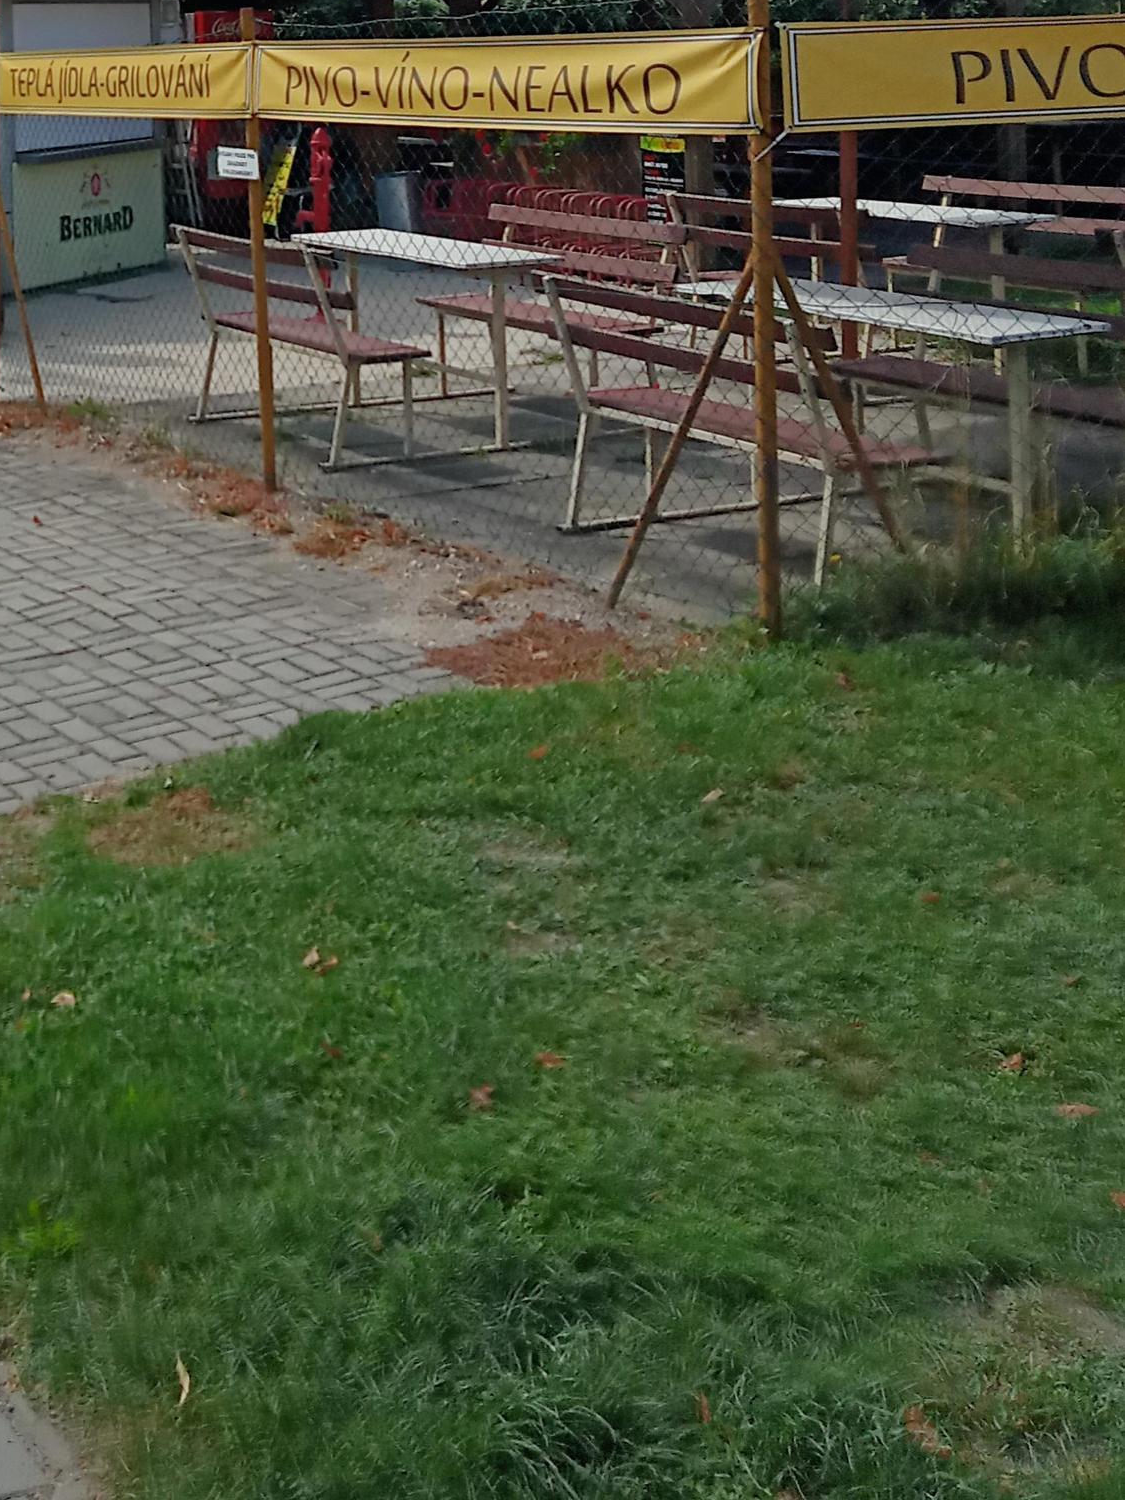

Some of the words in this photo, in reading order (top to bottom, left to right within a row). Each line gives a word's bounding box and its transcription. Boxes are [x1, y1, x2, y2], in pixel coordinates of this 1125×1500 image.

[10, 60, 55, 98] TEPLÁ
[58, 54, 211, 103] JÍDLA-GRILOVÁNÍ
[285, 51, 683, 115] PIVO-VÍNO-NEALKO
[60, 205, 134, 241] BERNARD
